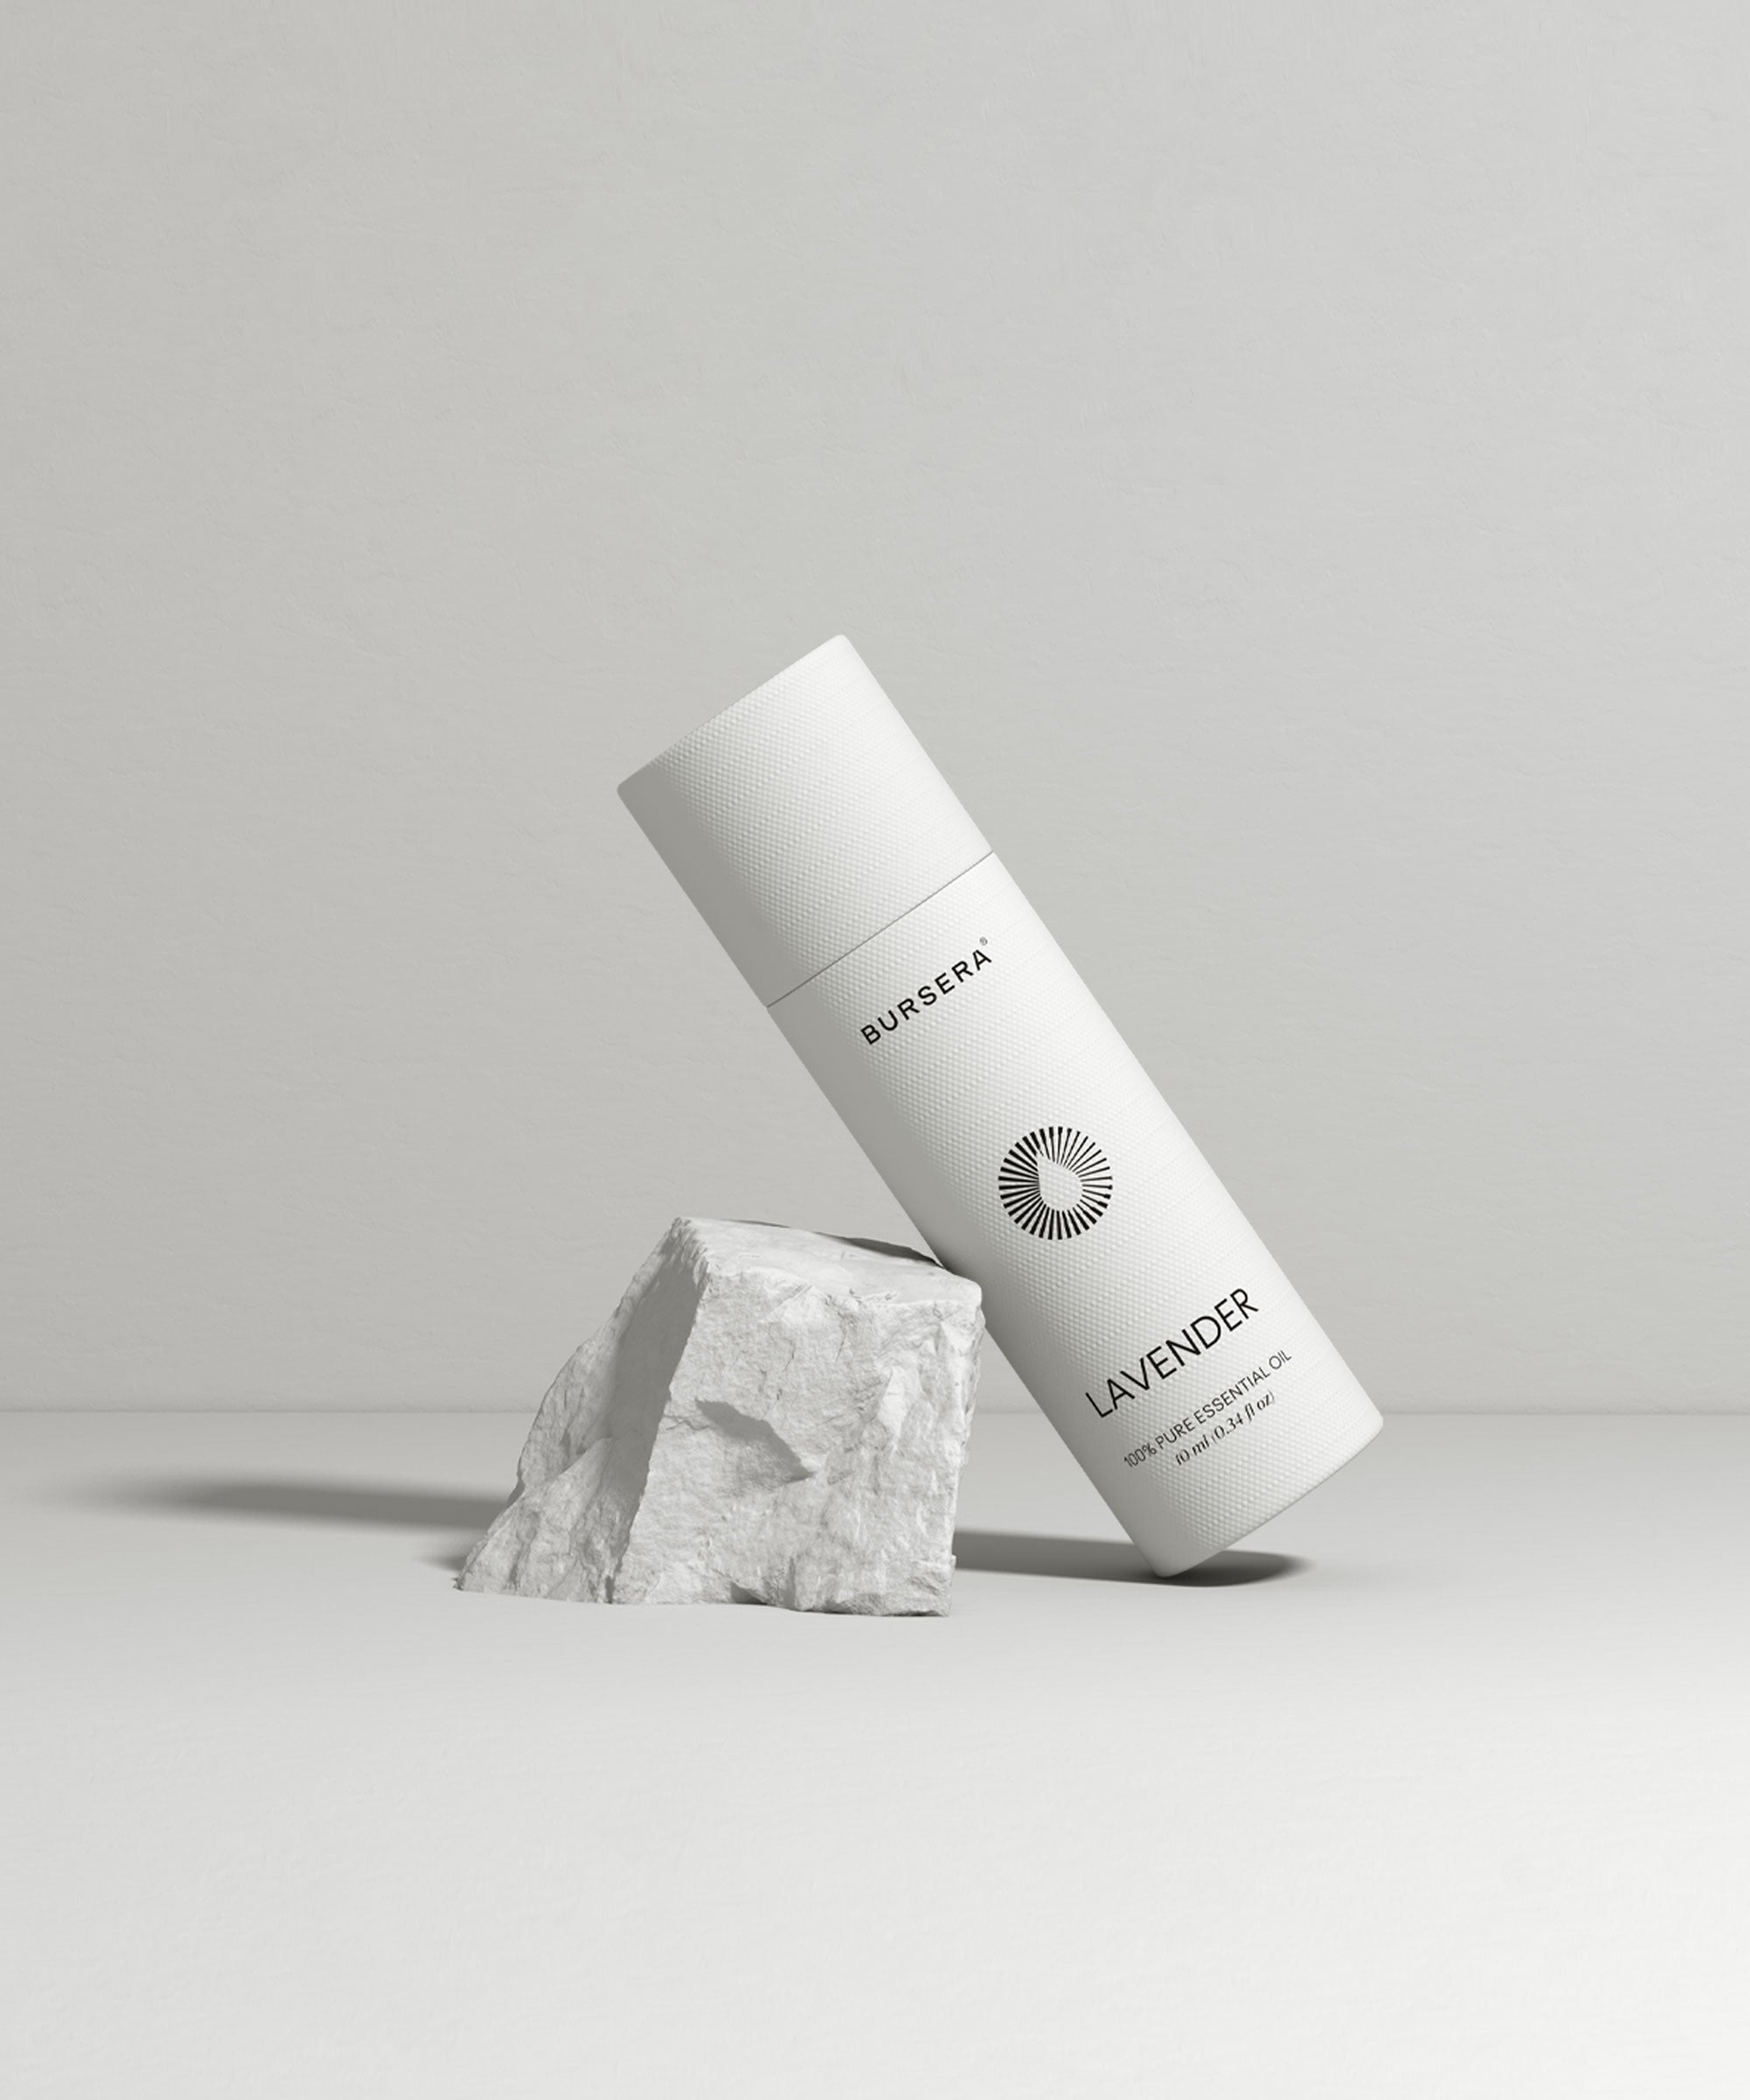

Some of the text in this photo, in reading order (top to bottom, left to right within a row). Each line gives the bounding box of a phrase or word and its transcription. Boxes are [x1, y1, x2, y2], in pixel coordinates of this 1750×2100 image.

[1085, 1288, 1259, 1418] LAVENDER
[1124, 1350, 1292, 1468] 100% PURE ESSENTIAL OIL
[1175, 1449, 1191, 1466] 10
[1192, 1434, 1209, 1457] ml
[1244, 1403, 1256, 1424] fl
